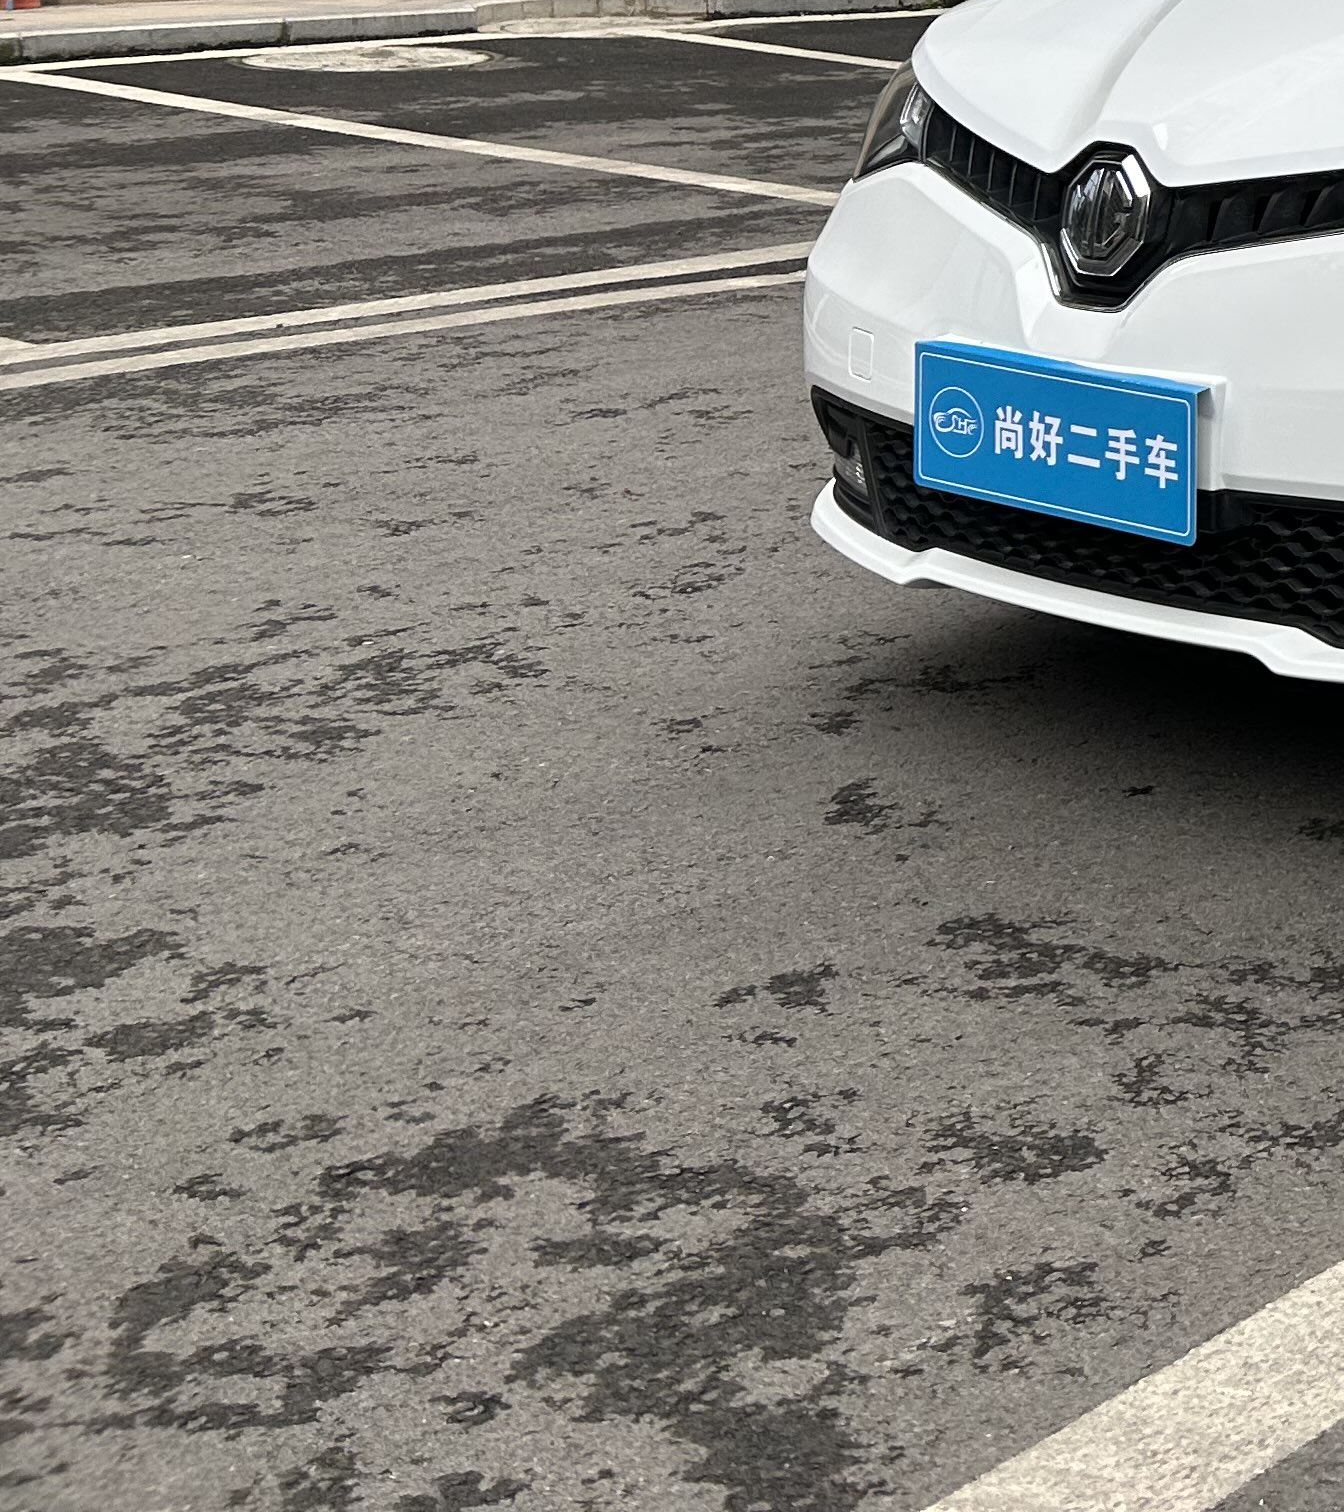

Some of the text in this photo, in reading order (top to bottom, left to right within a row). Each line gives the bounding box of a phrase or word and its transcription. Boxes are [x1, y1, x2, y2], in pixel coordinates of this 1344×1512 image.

[994, 405, 1178, 488] 尚好二手车
